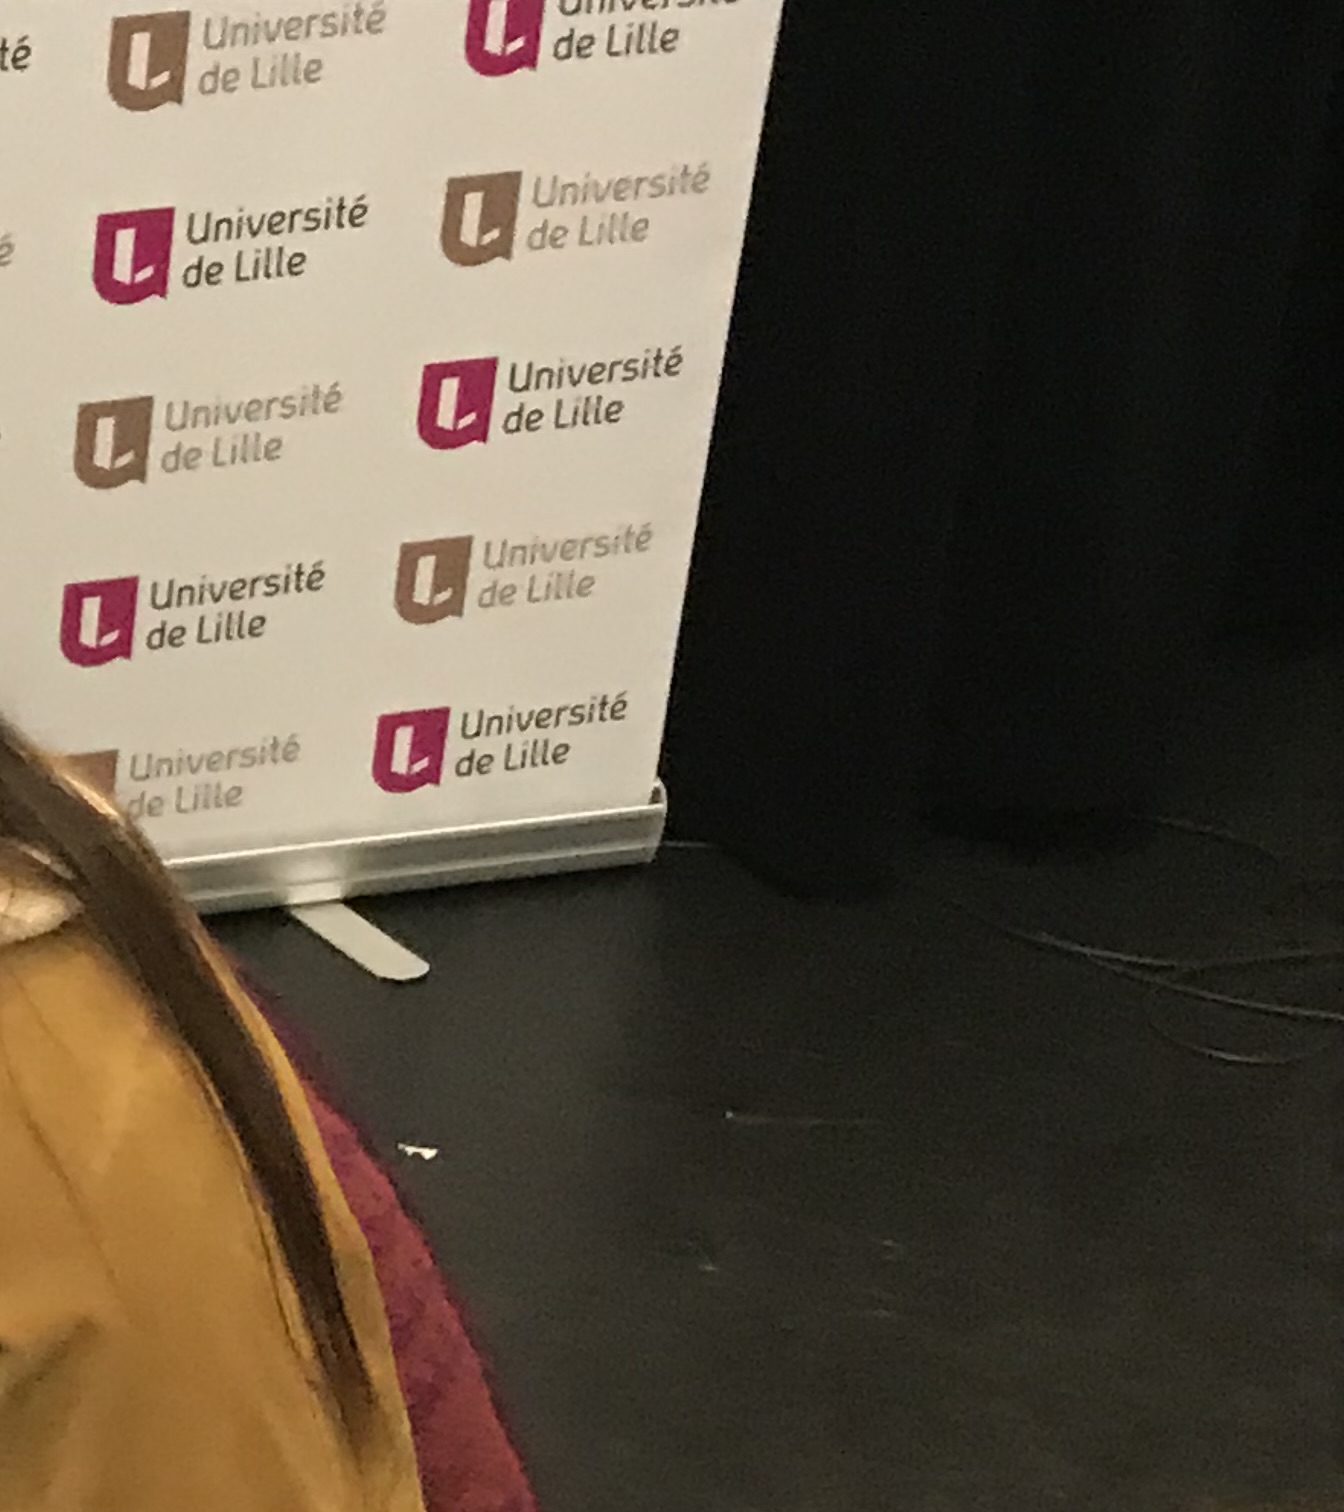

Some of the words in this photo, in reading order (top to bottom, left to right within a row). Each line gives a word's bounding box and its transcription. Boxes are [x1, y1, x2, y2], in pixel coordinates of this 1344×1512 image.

[202, 0, 387, 51] Université
[552, 27, 596, 61] de
[605, 20, 680, 58] Lille
[197, 62, 241, 96] de
[250, 52, 324, 91] Lille
[531, 161, 711, 209] Université
[186, 193, 369, 246] Université
[526, 218, 570, 251] de
[577, 211, 650, 247] Lille
[182, 255, 225, 289] de
[235, 245, 307, 283] Lille
[508, 344, 684, 394] Université
[164, 380, 343, 433] Université
[501, 402, 545, 435] de
[553, 394, 625, 430] Lille
[160, 441, 203, 474] de
[211, 431, 283, 468] Lille
[482, 521, 654, 573] Université
[150, 560, 326, 612] Université
[477, 579, 518, 609] de
[526, 569, 596, 604] Lille
[145, 619, 187, 651] de
[196, 609, 267, 645] Lille
[460, 690, 628, 740] Université
[129, 733, 301, 783] Université
[454, 748, 495, 778] de
[503, 738, 571, 772] Lille
[127, 790, 165, 820] de
[174, 781, 244, 815] Lille
